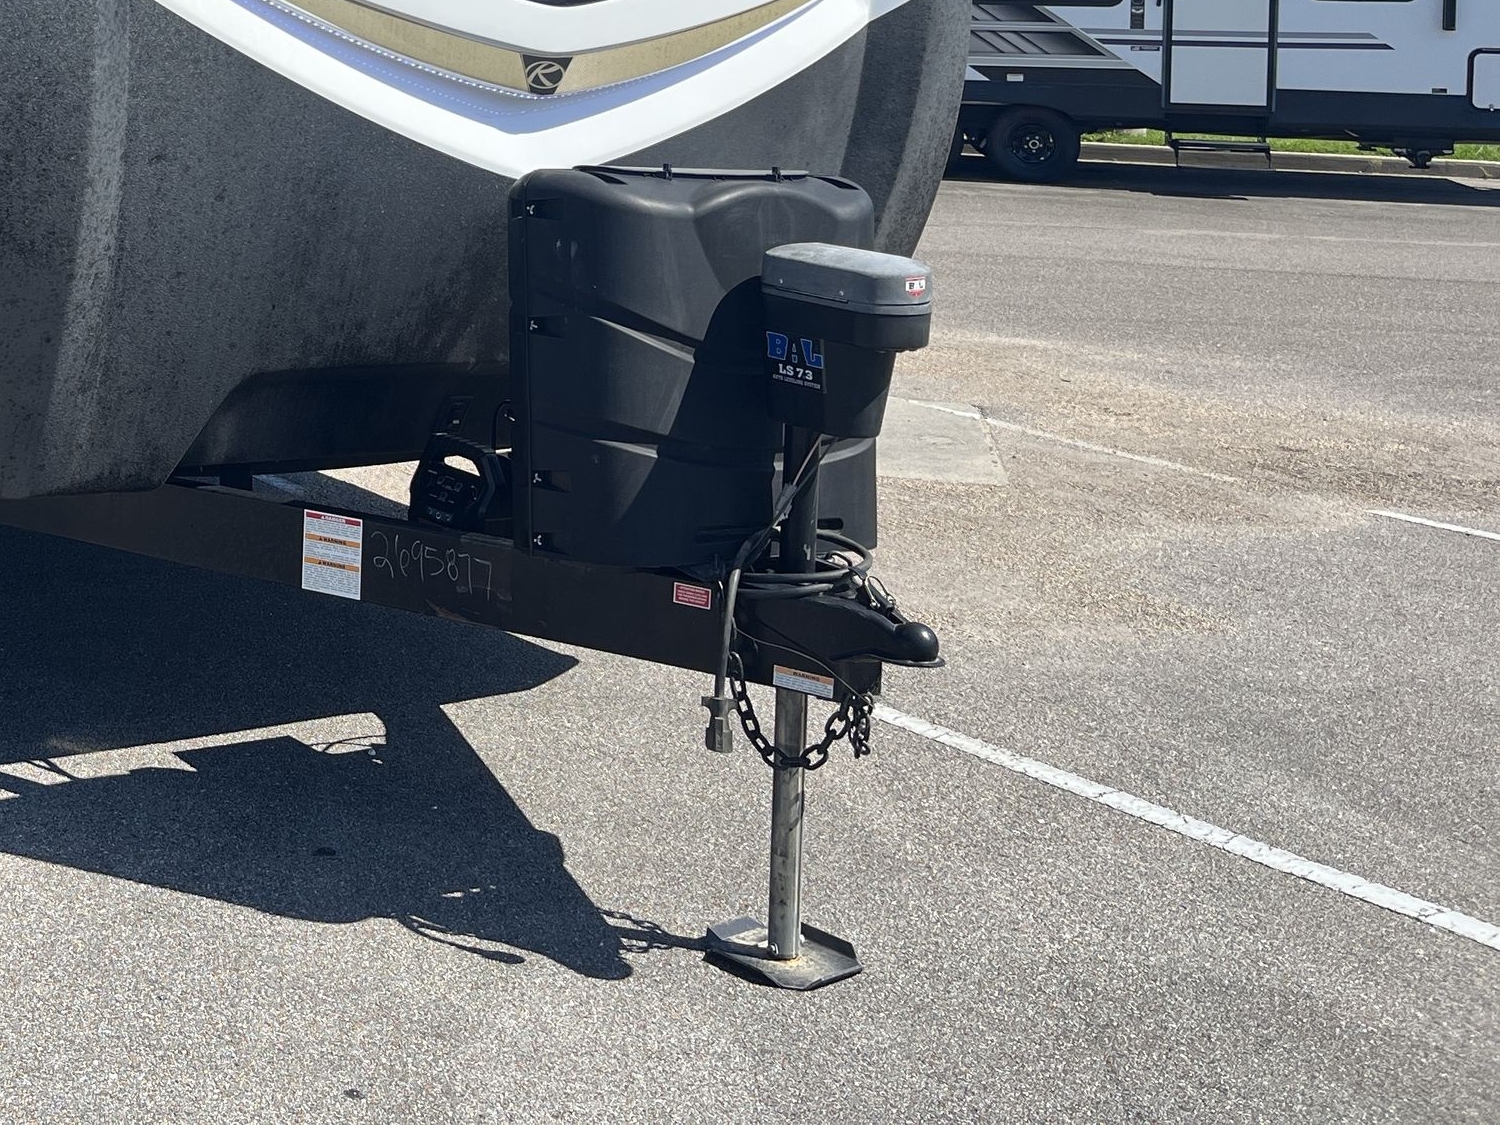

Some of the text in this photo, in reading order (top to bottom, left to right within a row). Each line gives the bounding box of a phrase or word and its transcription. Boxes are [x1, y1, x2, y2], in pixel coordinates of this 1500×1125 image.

[778, 363, 794, 377] LS
[323, 537, 347, 546] WARNING
[322, 560, 346, 569] WARNING
[792, 671, 821, 682] WARNING
